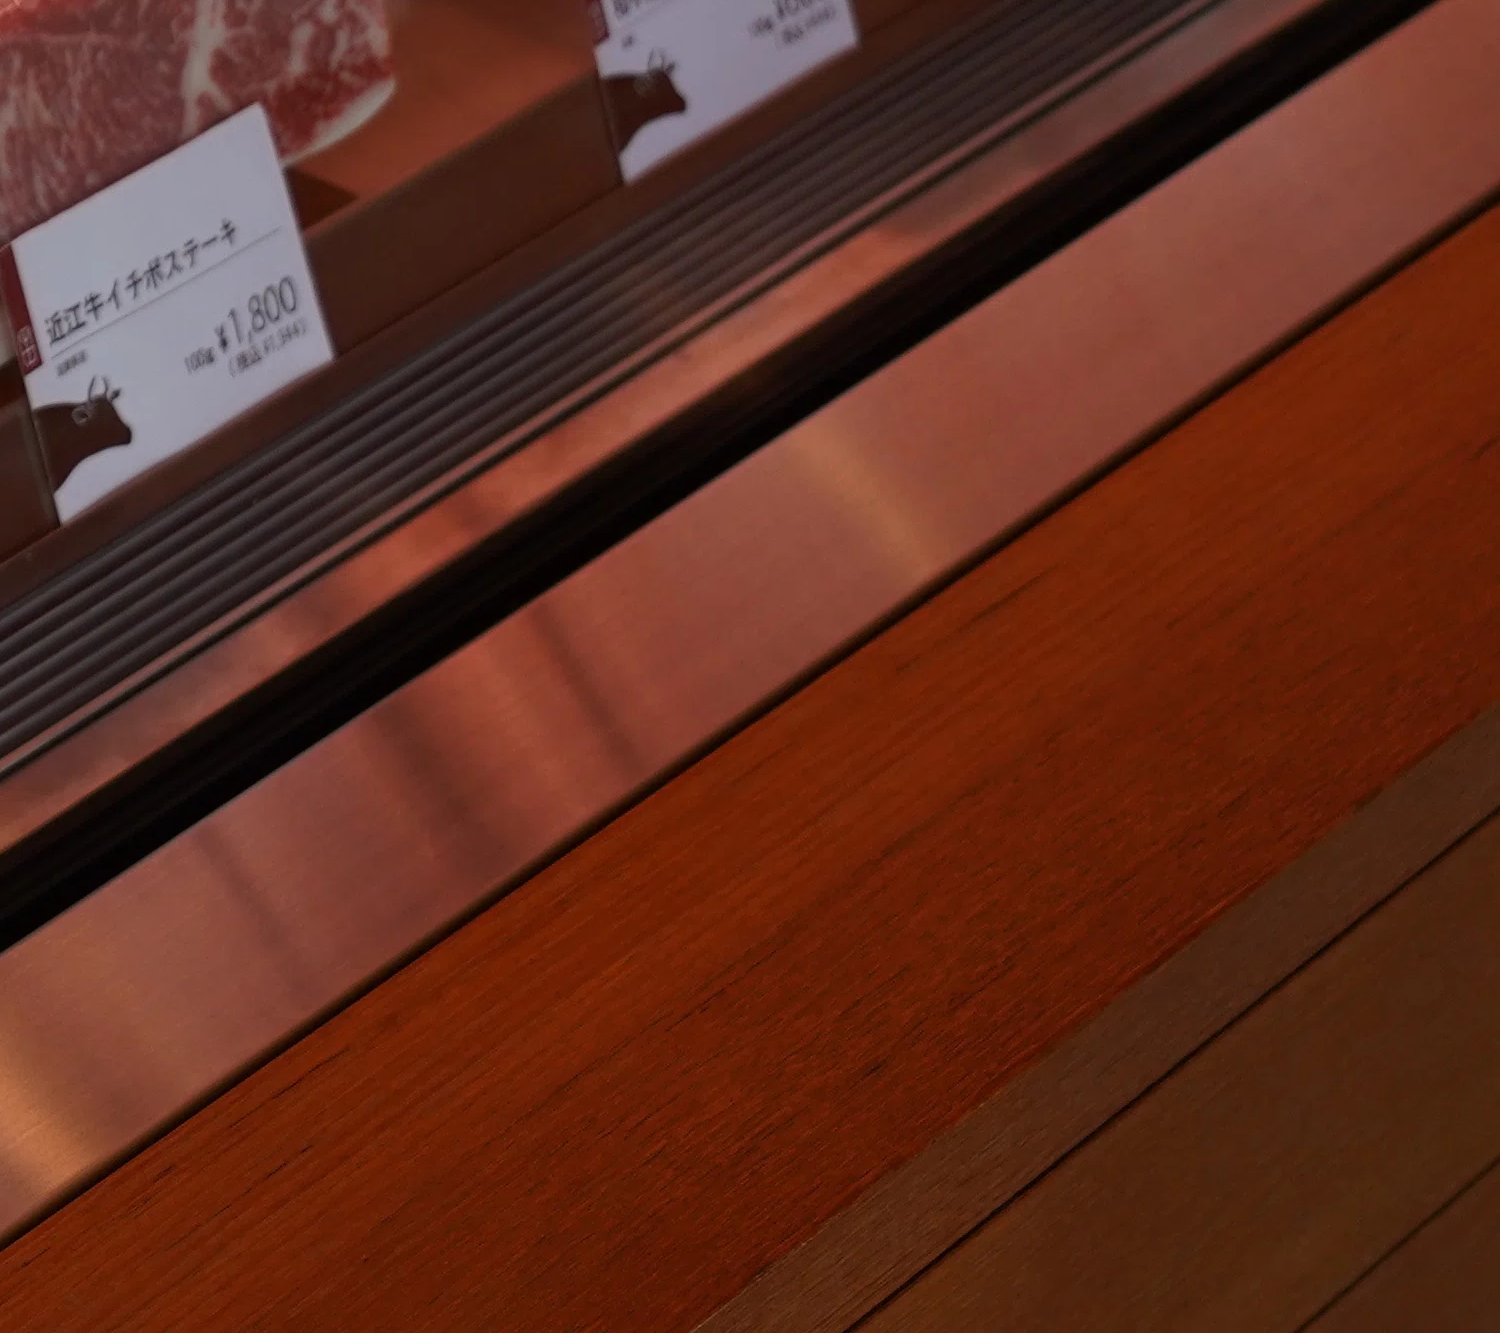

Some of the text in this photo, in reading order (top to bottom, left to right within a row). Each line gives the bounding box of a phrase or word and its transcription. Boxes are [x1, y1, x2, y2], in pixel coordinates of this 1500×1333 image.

[44, 218, 236, 347] 近江牛イチボステーキ
[215, 275, 298, 354] ¥1,800
